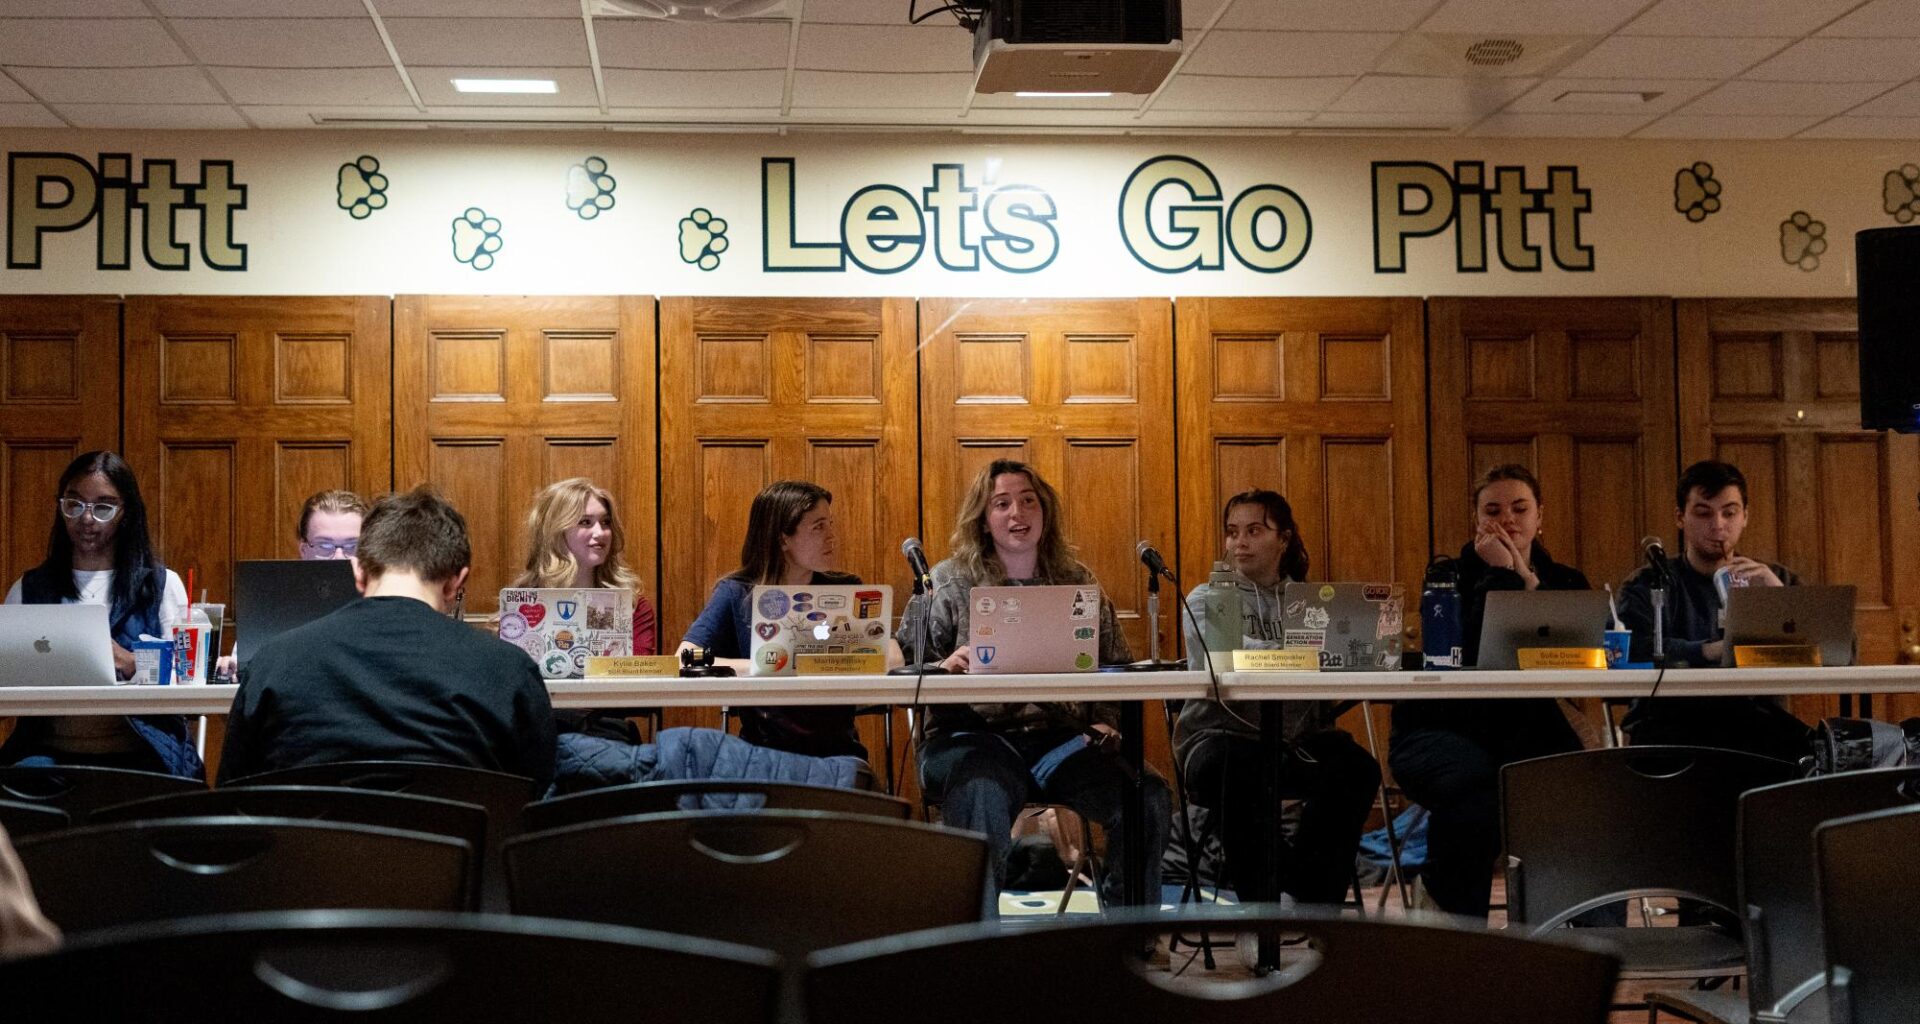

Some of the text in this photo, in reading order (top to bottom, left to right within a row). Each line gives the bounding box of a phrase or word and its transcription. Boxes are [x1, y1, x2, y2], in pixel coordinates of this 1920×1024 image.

[7, 152, 247, 271] Pitt
[761, 154, 1595, 274] Let's Go Pitt
[506, 595, 537, 604] DIGNITY
[1319, 652, 1342, 666] Pitt
